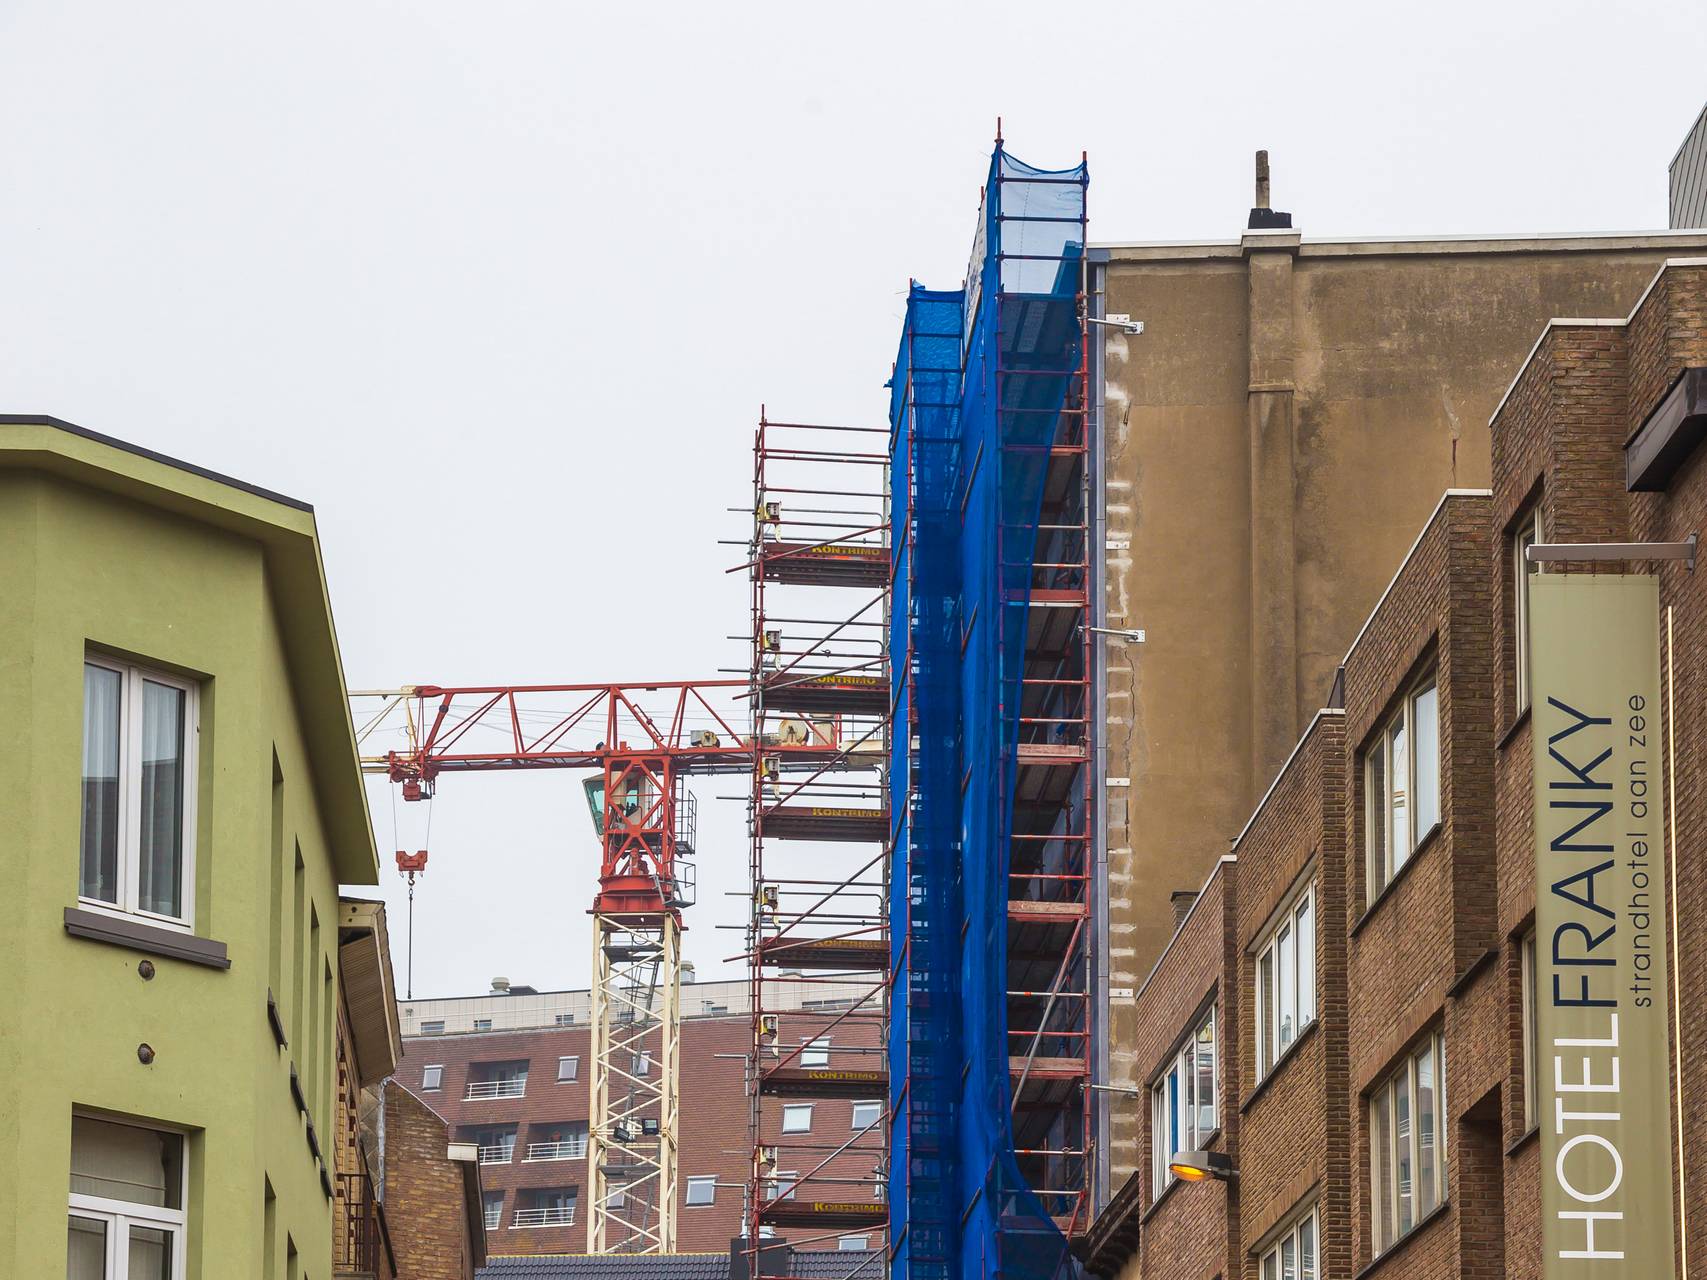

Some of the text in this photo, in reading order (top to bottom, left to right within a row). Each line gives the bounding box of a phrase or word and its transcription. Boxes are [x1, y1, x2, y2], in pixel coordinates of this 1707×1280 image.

[1547, 696, 1624, 1258] HOTEL FRANKY
[1626, 694, 1652, 1008] strandhotel aan zee
